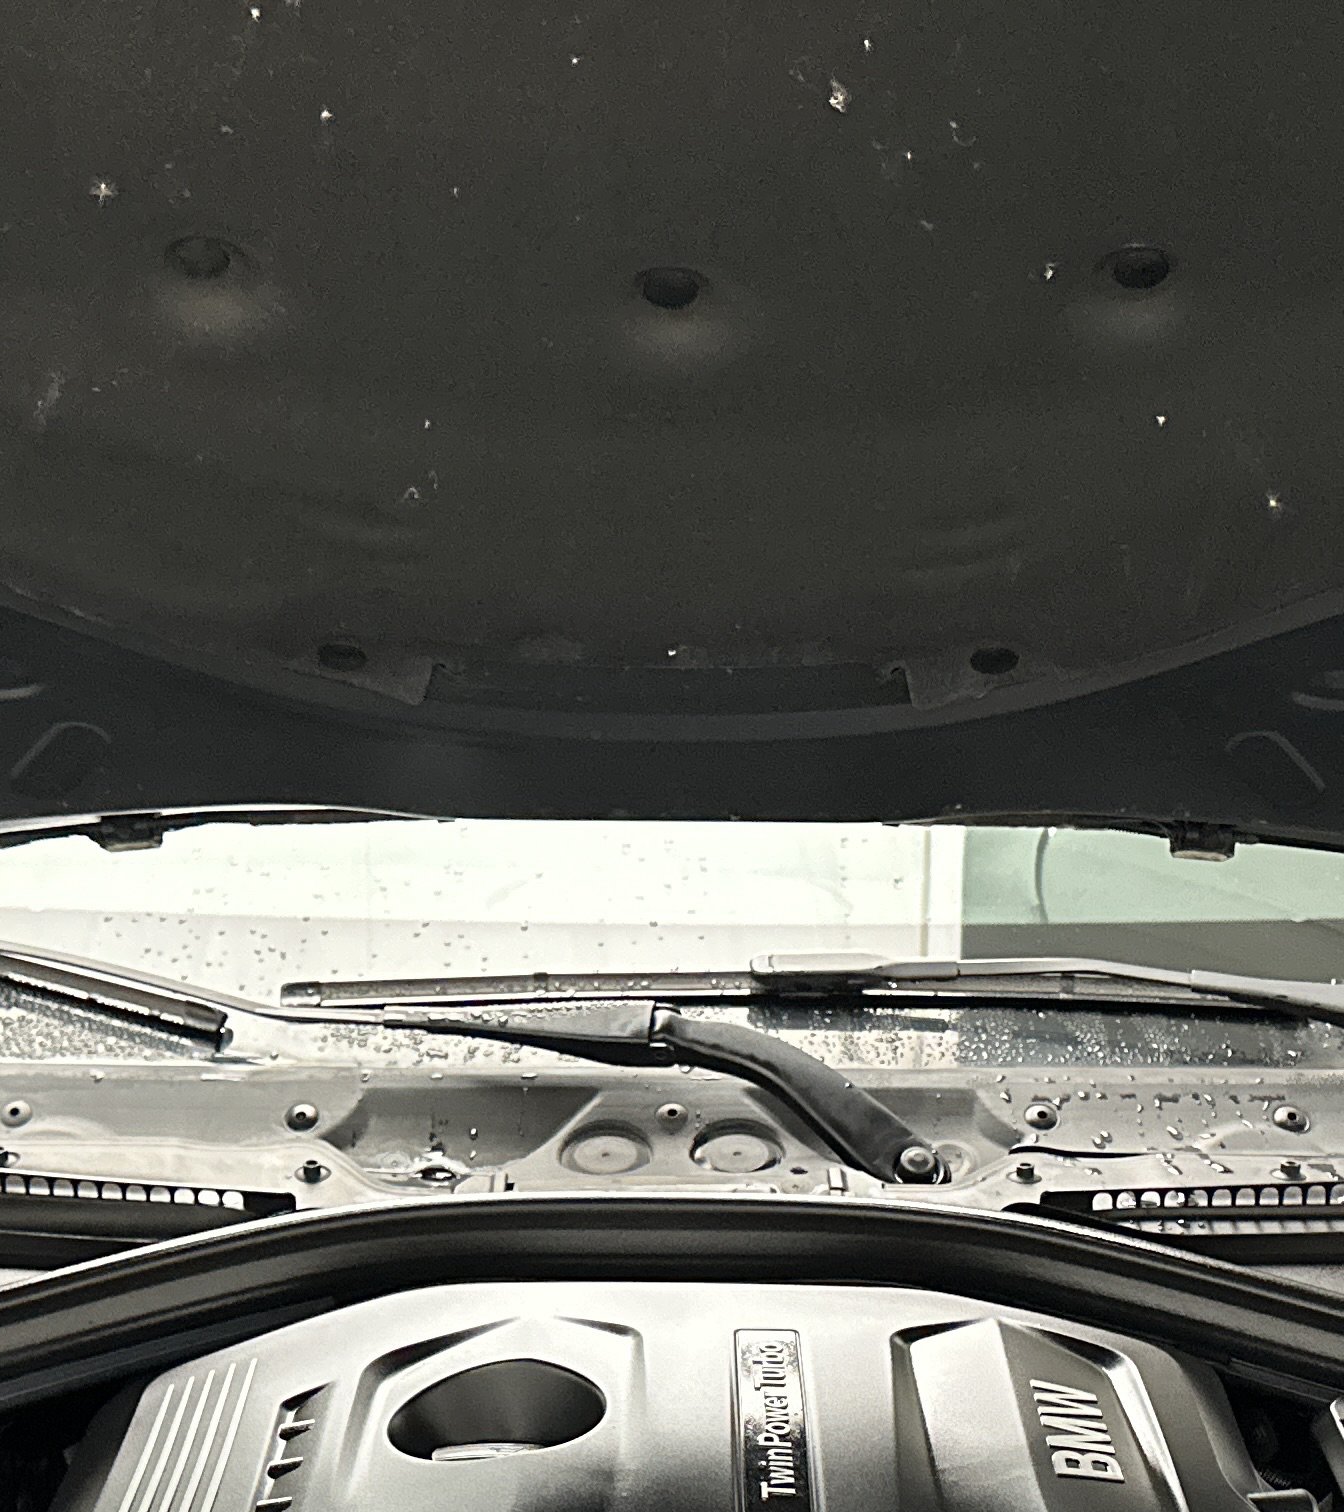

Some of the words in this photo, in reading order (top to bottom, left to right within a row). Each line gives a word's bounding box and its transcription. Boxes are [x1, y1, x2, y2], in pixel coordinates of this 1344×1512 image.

[752, 1340, 787, 1391] Turbo
[758, 1391, 797, 1501] TwinPower
[1030, 1379, 1125, 1484] BMW
